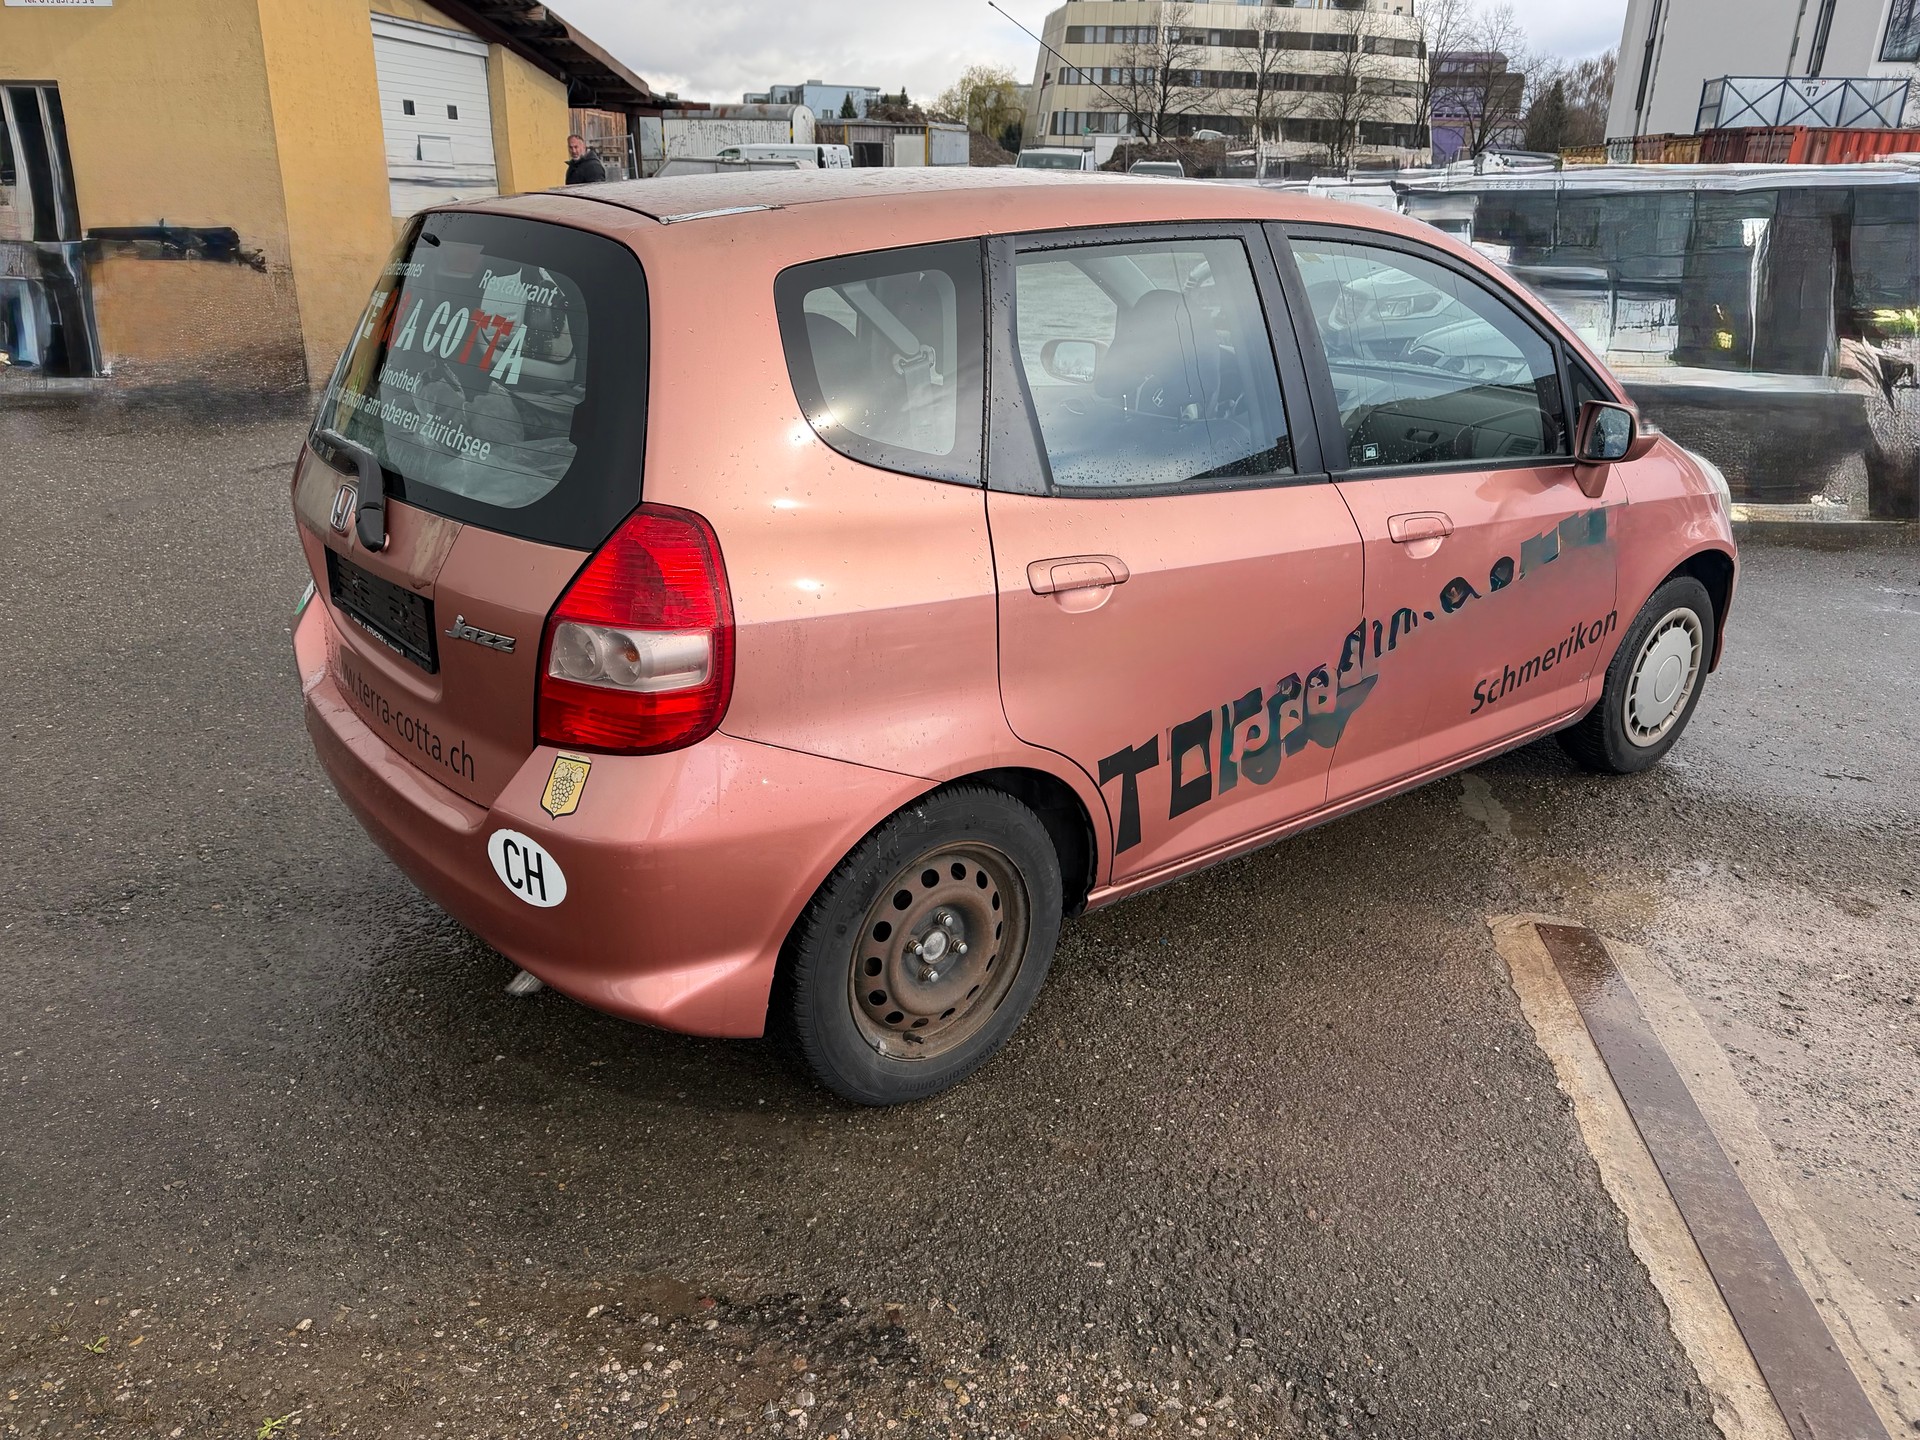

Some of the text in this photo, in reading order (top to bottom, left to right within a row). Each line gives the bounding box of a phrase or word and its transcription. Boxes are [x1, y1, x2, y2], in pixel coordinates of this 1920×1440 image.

[1805, 86, 1820, 97] 17
[478, 269, 559, 307] Restaurant
[422, 300, 529, 385] COTTA
[377, 363, 422, 394] Vinothek
[364, 397, 381, 416] am
[380, 398, 420, 432] oberen
[419, 412, 492, 461] Zürichsee
[1470, 609, 1618, 715] Schmerikon
[502, 838, 548, 902] CH
